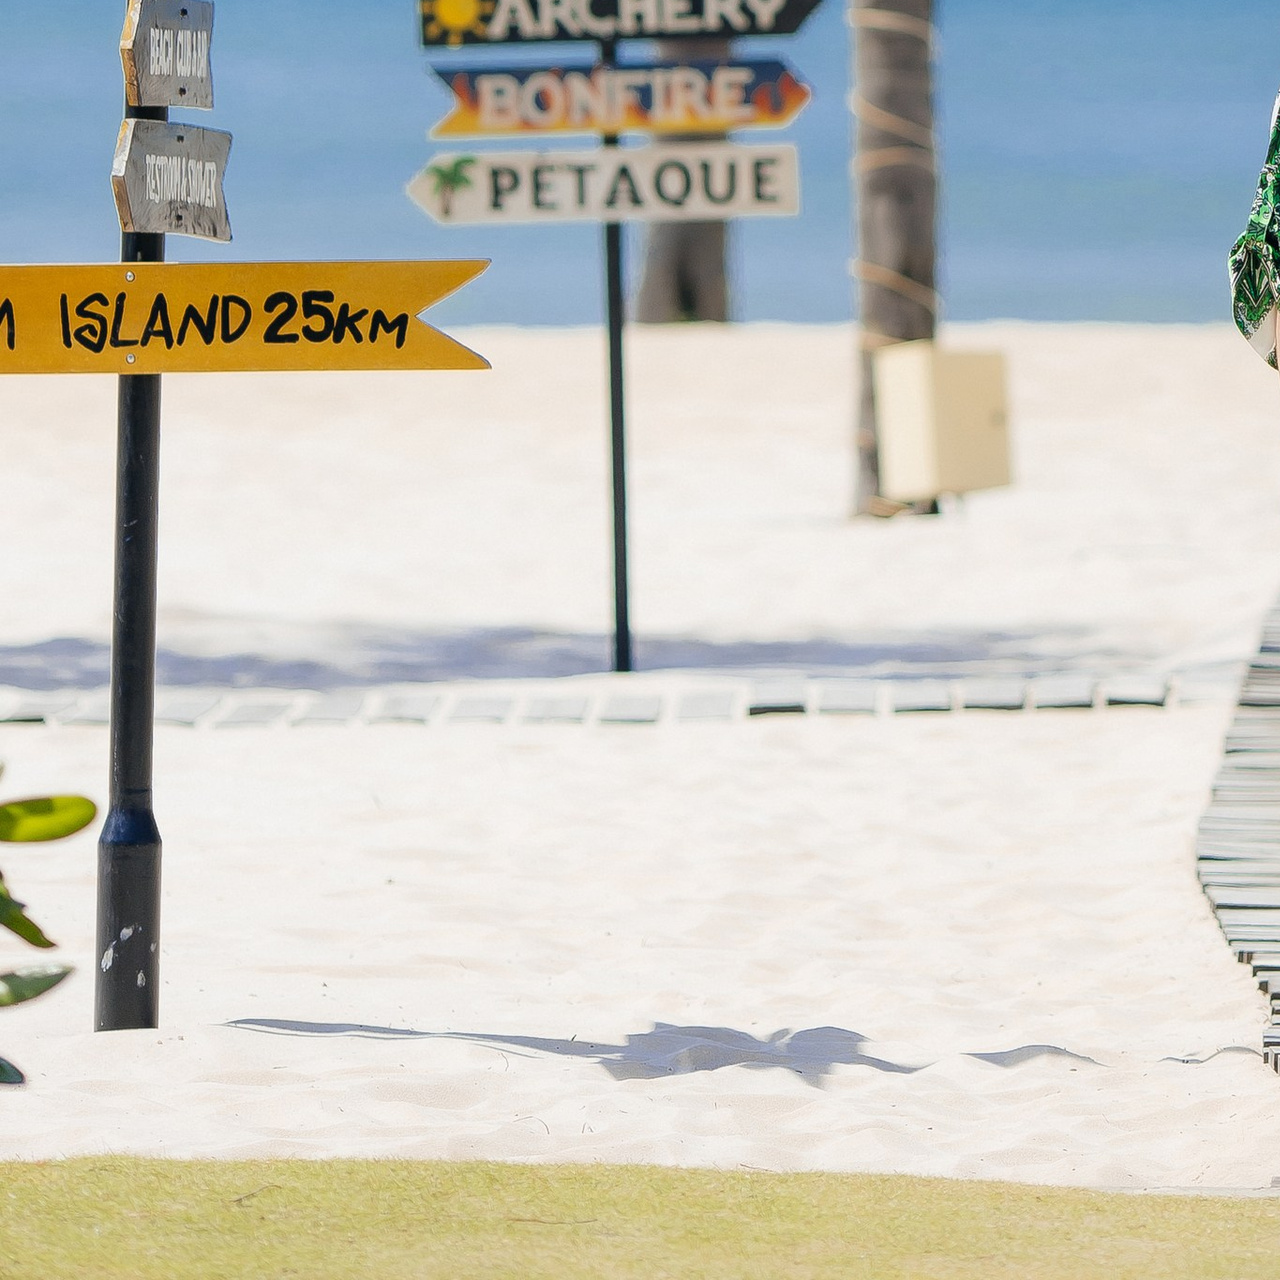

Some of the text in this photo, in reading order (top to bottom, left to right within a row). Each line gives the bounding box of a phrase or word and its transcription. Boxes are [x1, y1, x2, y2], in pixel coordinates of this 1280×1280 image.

[474, 66, 755, 130] BONFIRE
[487, 157, 784, 214] PETAQUE
[60, 291, 252, 353] ISLAND
[263, 291, 409, 349] 25KM
